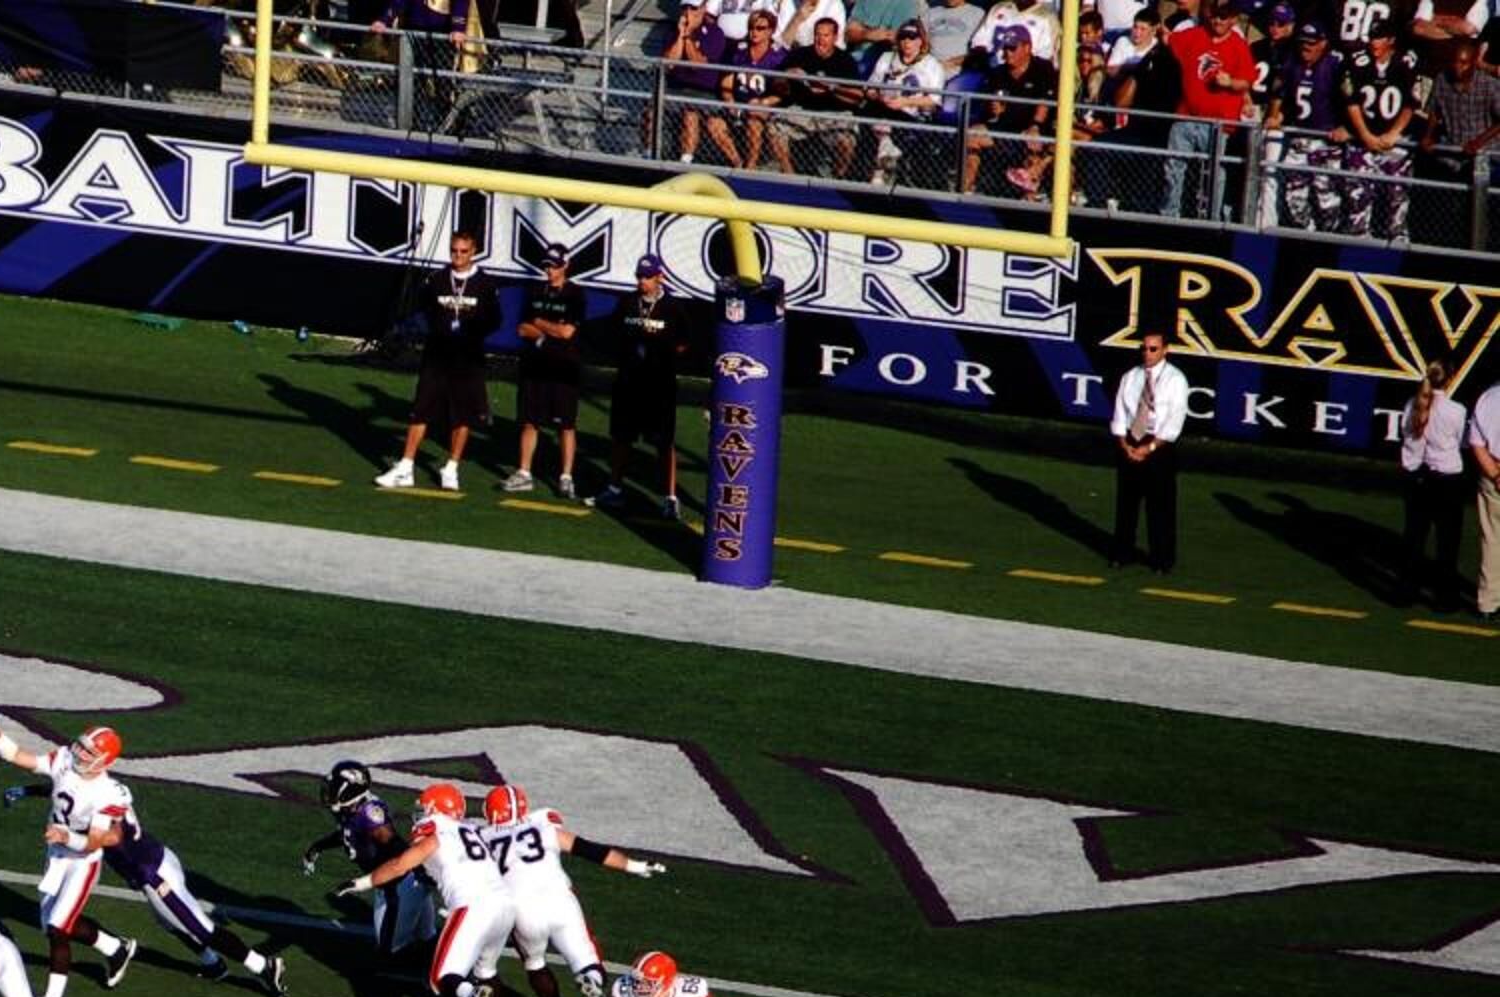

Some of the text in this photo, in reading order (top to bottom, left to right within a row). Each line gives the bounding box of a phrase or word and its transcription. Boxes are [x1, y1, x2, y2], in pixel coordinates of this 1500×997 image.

[1360, 85, 1402, 119] 20
[819, 344, 1403, 441] FOR TCKET
[713, 403, 756, 561] RAVENS
[458, 826, 492, 862] 6
[490, 827, 546, 876] 73
